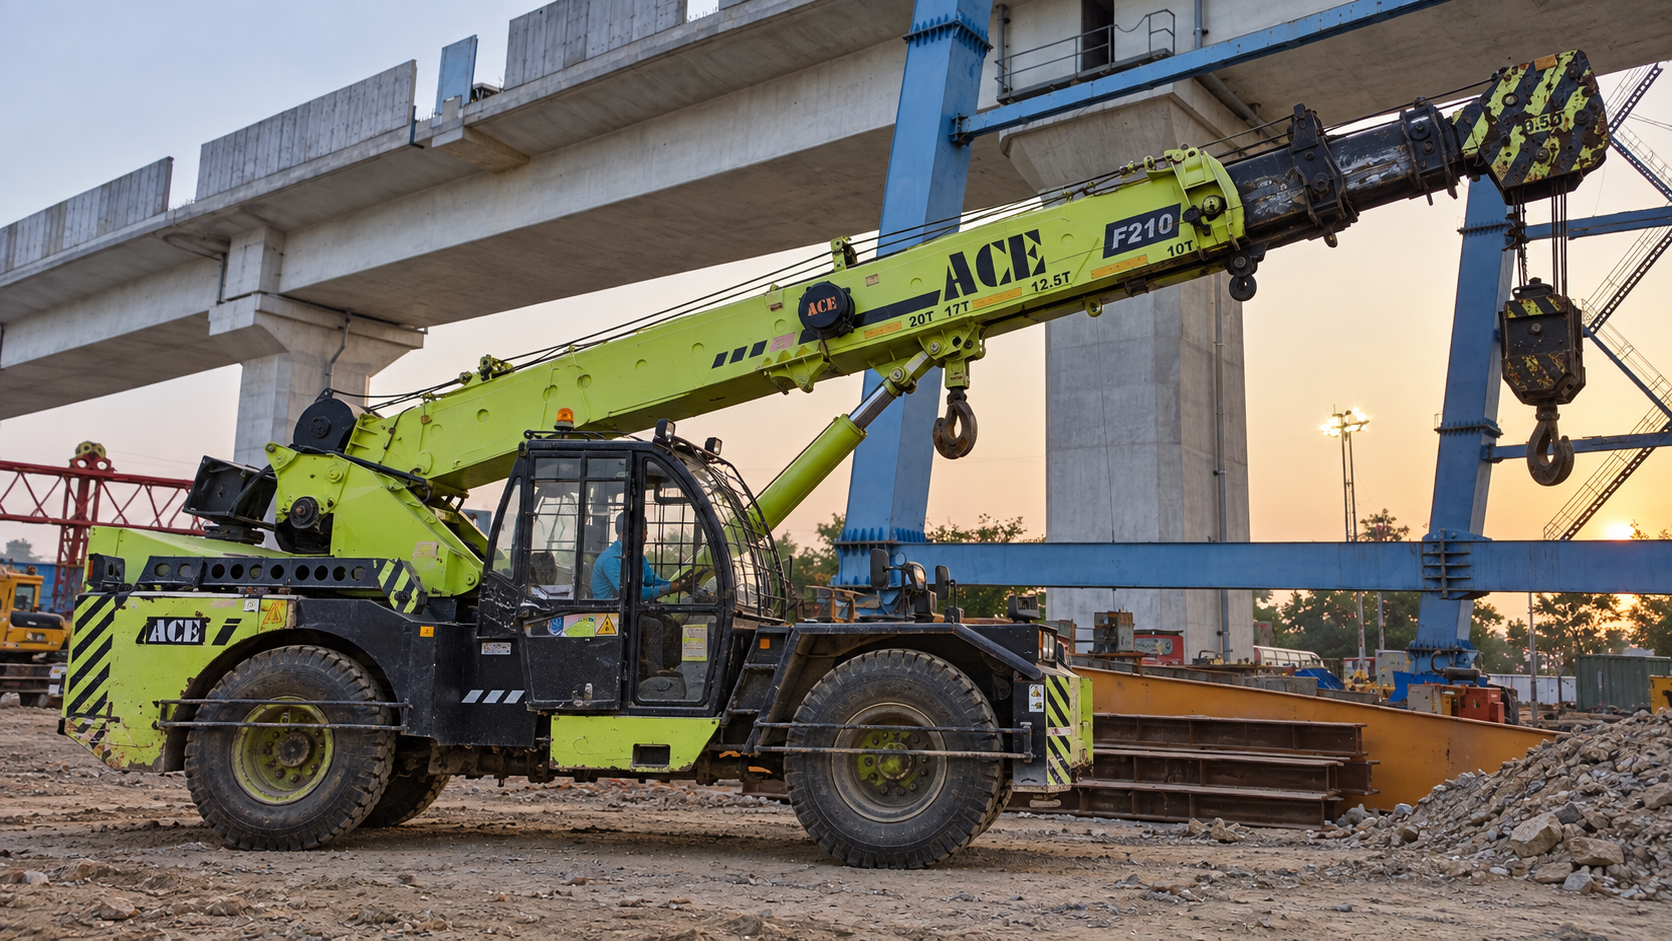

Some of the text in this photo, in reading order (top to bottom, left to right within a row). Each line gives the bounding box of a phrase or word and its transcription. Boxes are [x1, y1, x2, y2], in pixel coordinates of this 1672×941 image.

[1111, 212, 1173, 250] F210
[1166, 240, 1194, 258] 10T
[944, 229, 1046, 302] ACE
[1031, 270, 1071, 293] 12.5T
[807, 296, 838, 317] ACE
[944, 300, 970, 318] 17T
[908, 310, 935, 328] 20T
[148, 619, 201, 643] ACE
